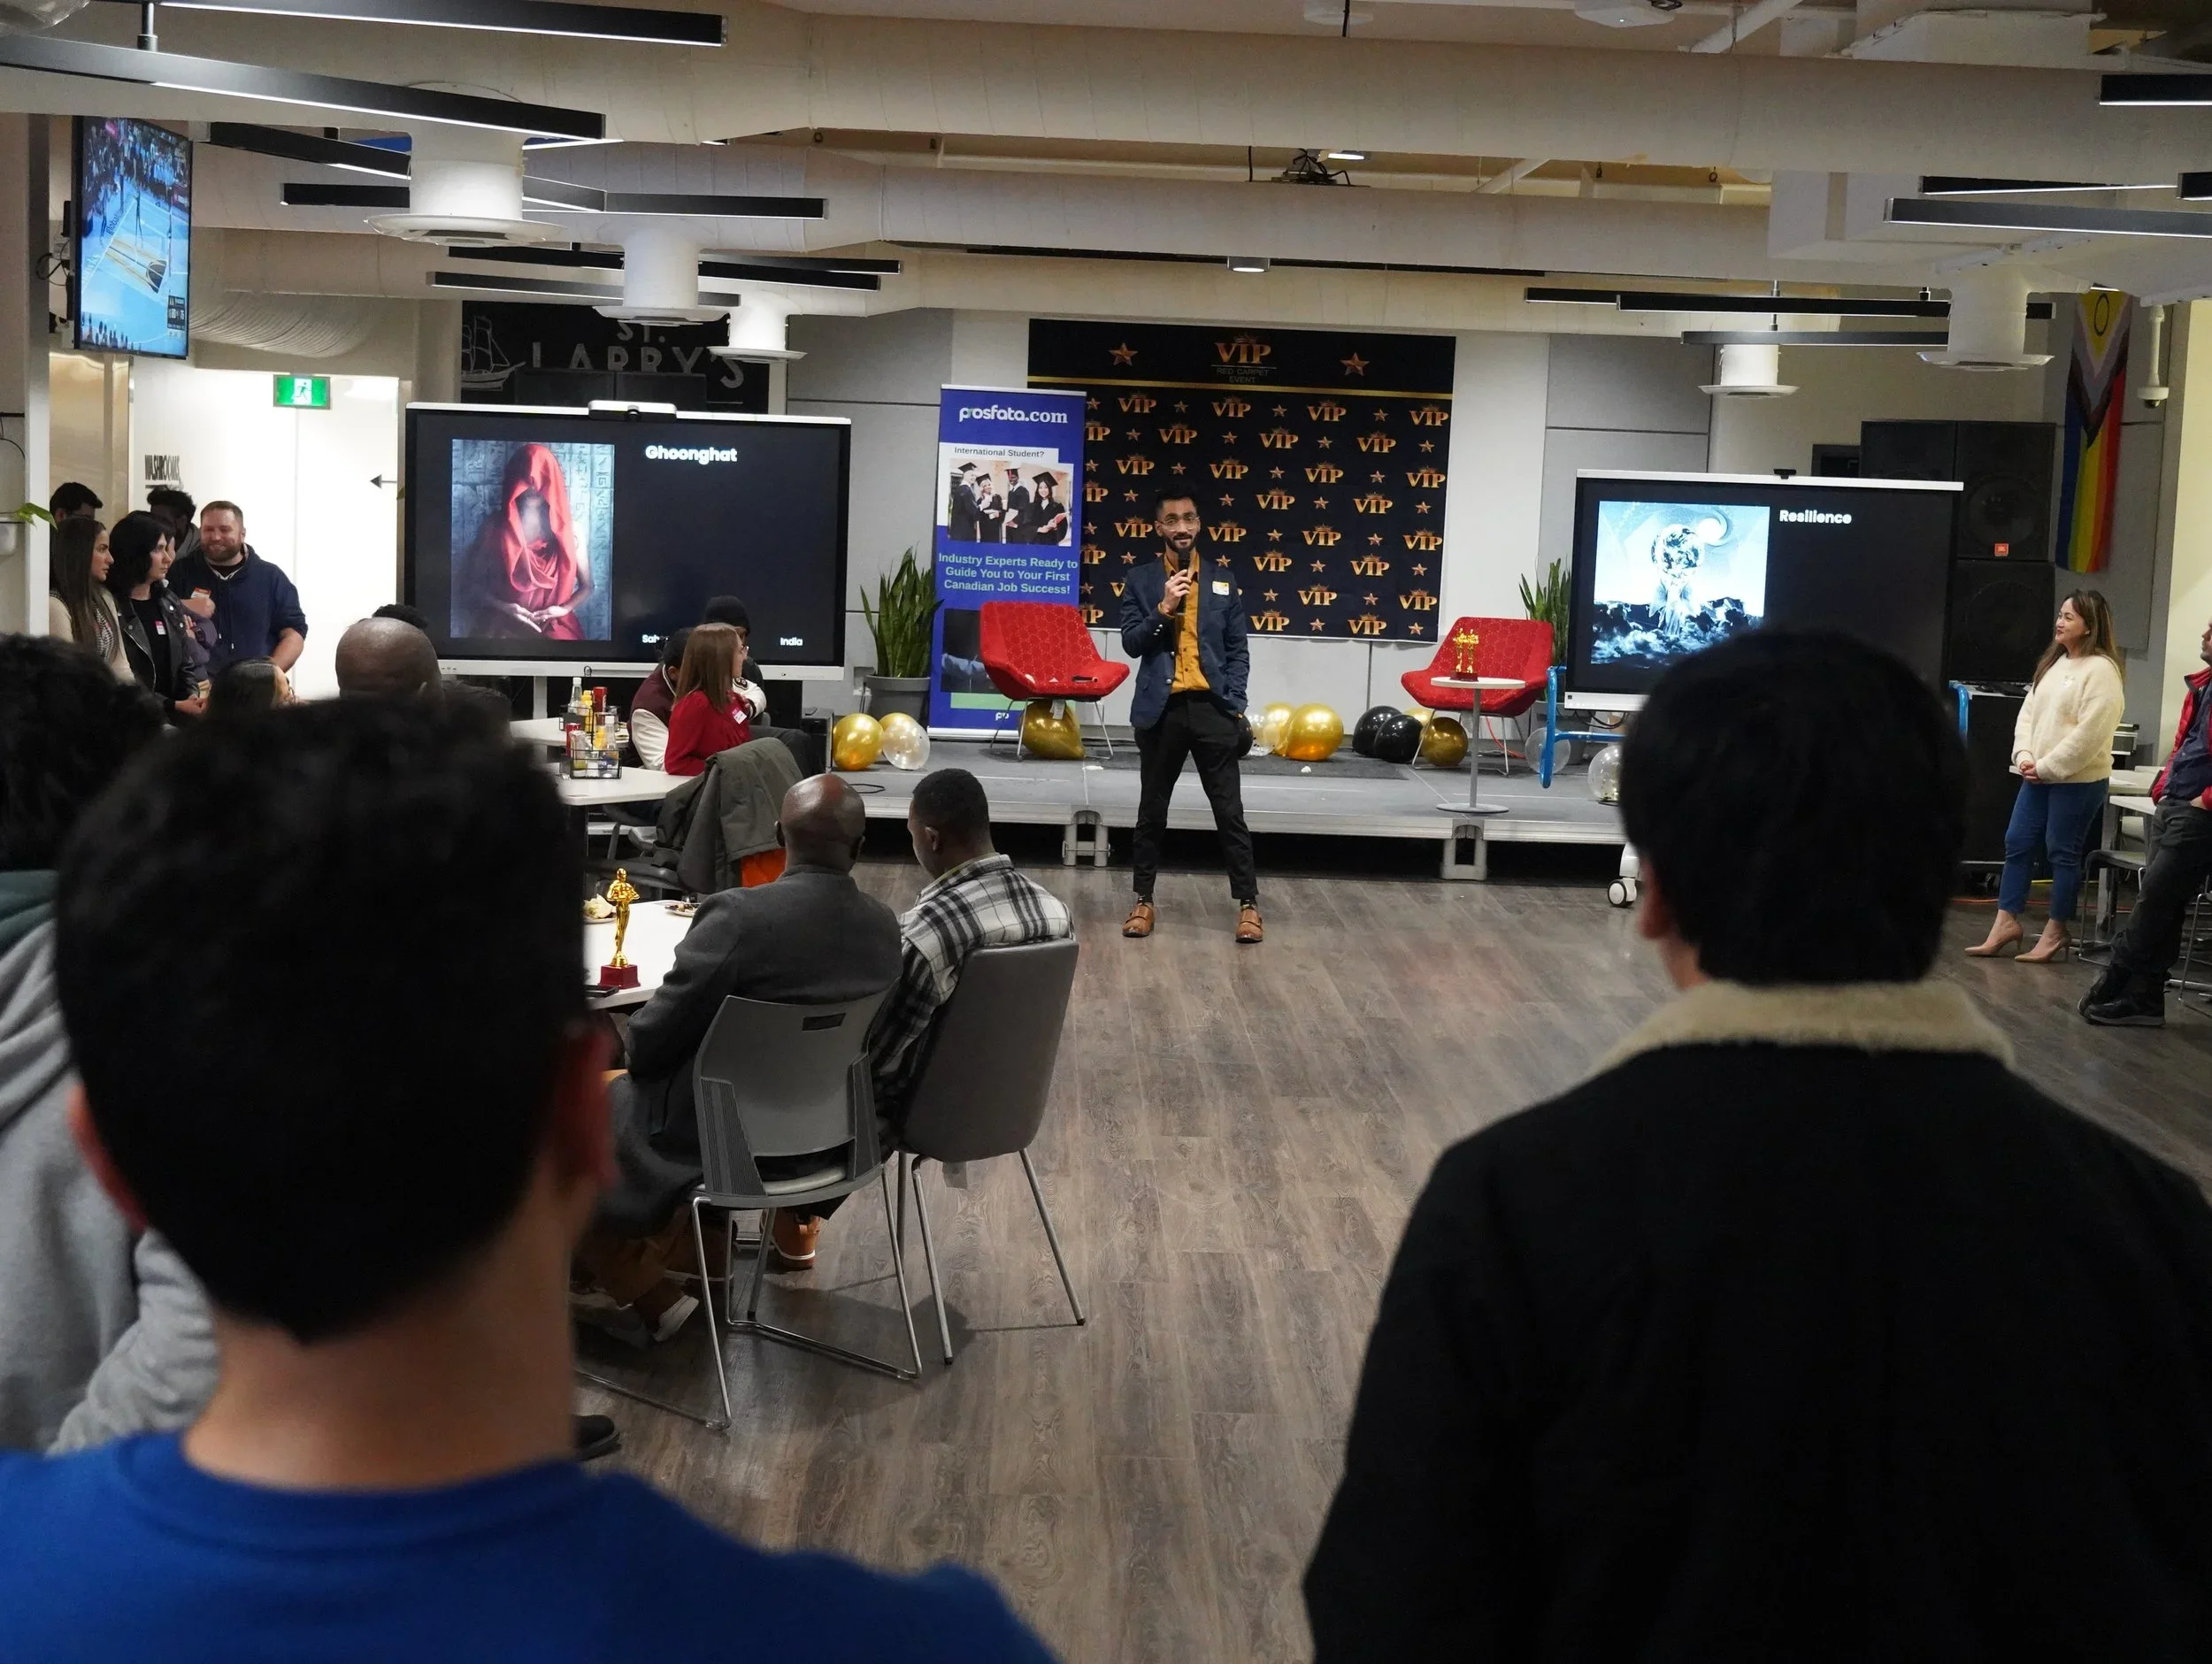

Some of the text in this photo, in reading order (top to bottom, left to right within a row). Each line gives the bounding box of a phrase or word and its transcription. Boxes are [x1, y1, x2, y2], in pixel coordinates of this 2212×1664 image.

[1213, 342, 1271, 364] VIP
[1118, 398, 1448, 426] VIP VIP VIP VIP
[1087, 426, 1395, 453] IP VIP VIP VIP
[645, 445, 738, 465] Ghoonghat
[955, 447, 1045, 458] International Student?
[1116, 460, 1445, 488] VIP VIP VIP VIP
[1085, 487, 1393, 514] IP VIP VIP
[1779, 510, 1852, 525] Resilience
[1114, 522, 1442, 551] VIP VIP VIP VIP
[939, 552, 1079, 571] Industry Experts Ready to
[1084, 549, 1389, 577] IP VIP VIP
[945, 566, 1071, 581] Guide You to Your First
[944, 579, 1071, 594] Canadian Job Success!
[1298, 590, 1437, 610] VIP VIP
[1082, 608, 1386, 635] IP VIP VIP
[780, 636, 803, 647] India
